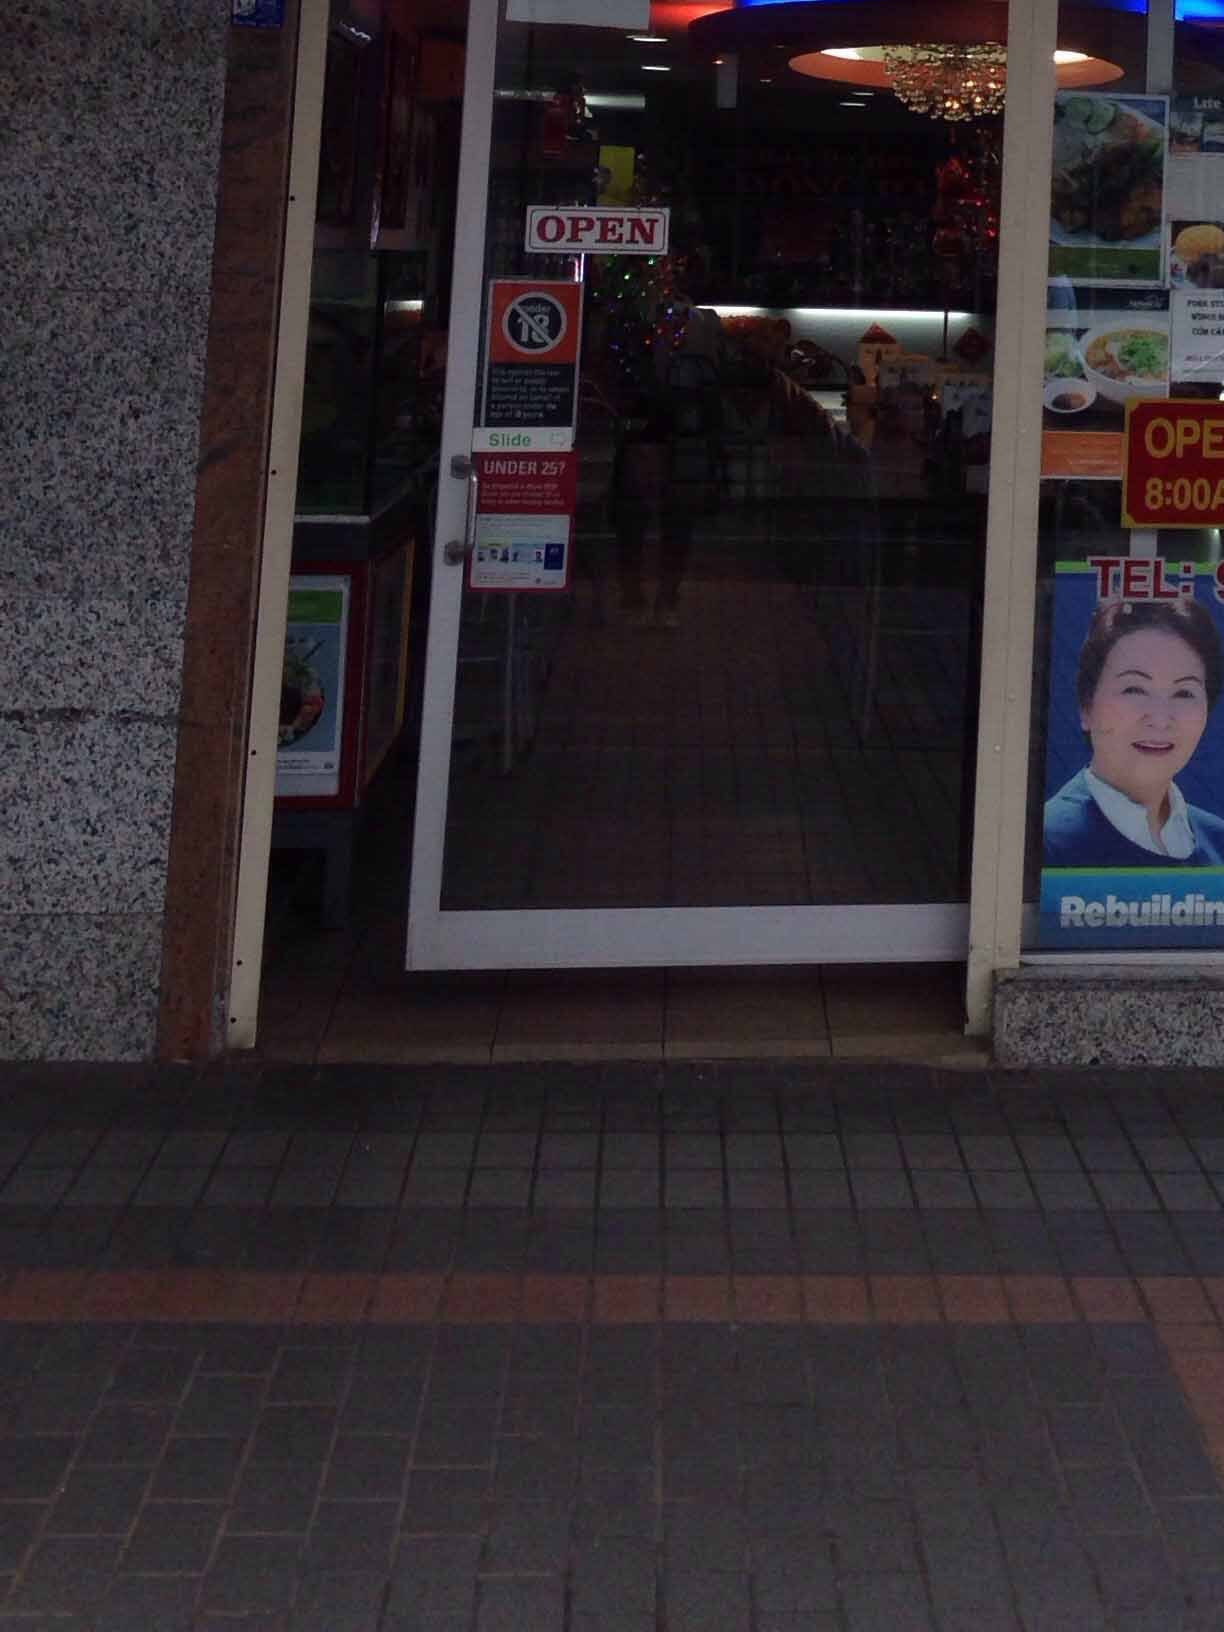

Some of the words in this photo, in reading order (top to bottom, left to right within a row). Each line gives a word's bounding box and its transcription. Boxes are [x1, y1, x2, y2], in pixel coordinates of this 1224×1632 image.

[537, 216, 657, 245] OPEN
[489, 432, 533, 448] Slide
[483, 459, 538, 475] UNDER
[1090, 557, 1195, 600] TEL:
